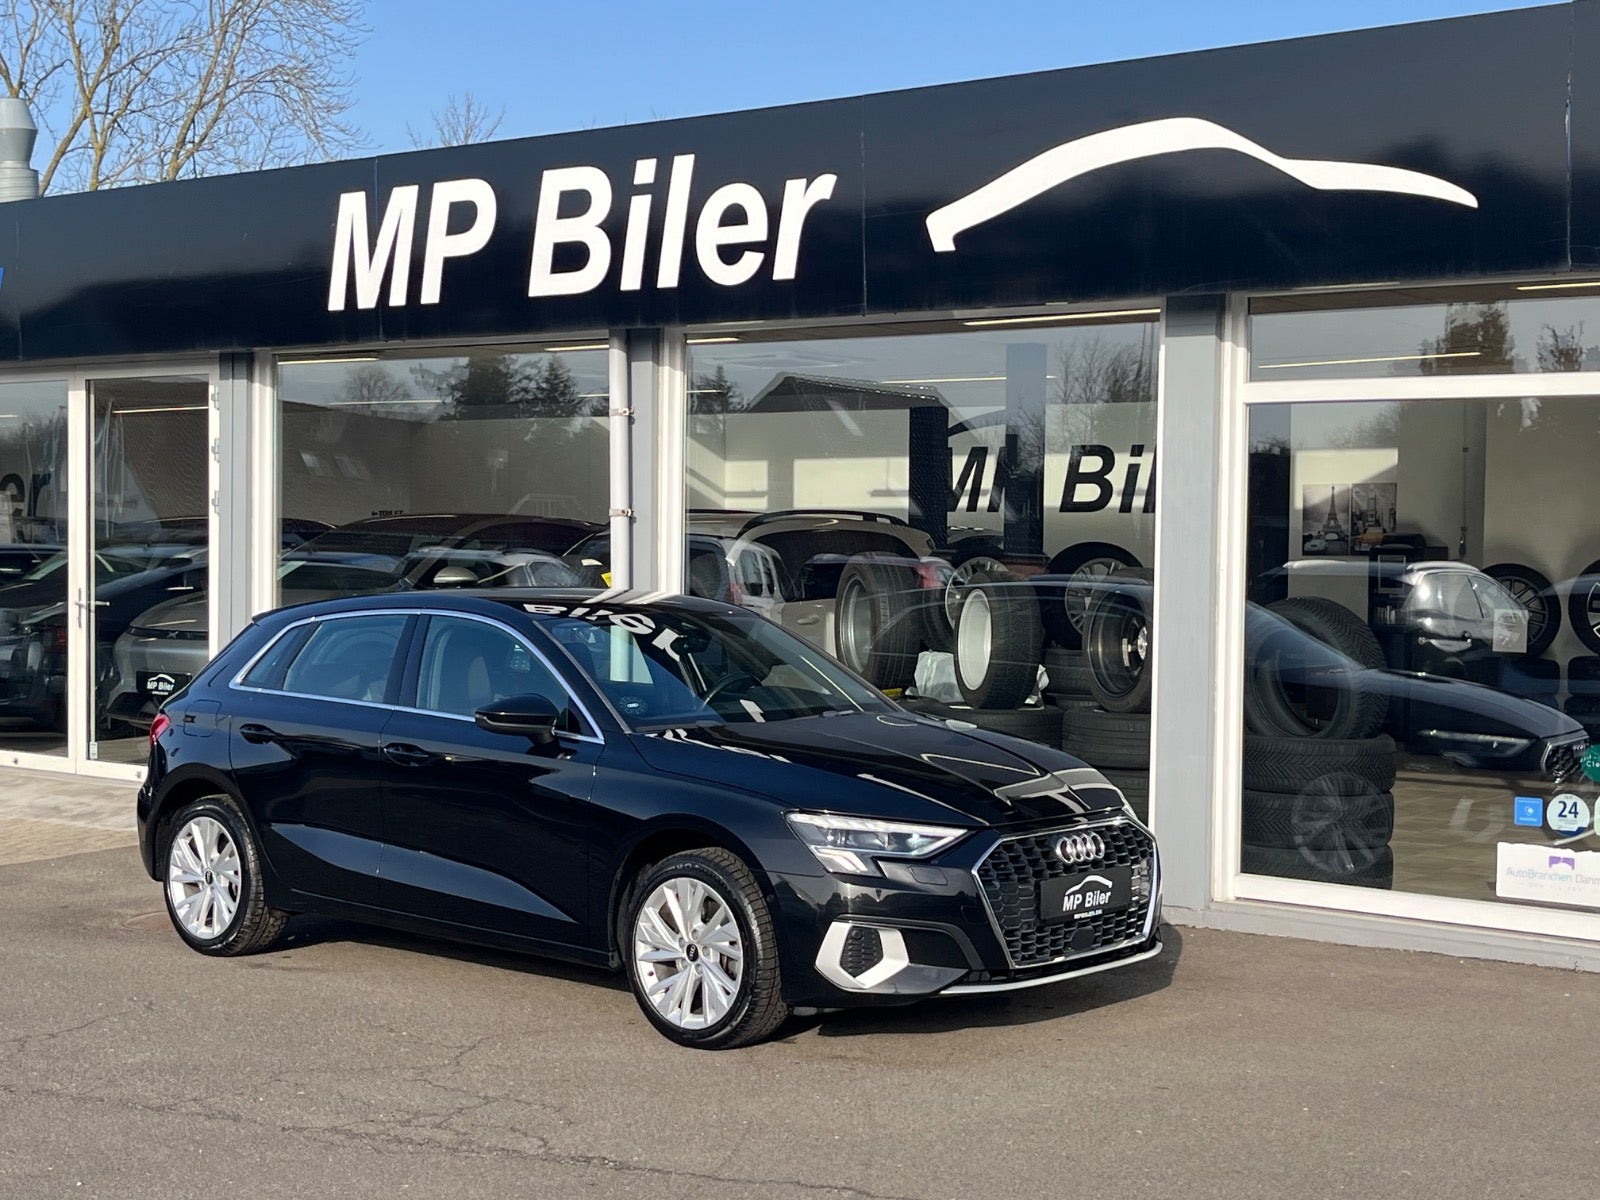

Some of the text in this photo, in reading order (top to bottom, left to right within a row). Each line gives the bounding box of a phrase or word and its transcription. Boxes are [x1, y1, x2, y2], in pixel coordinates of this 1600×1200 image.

[328, 154, 837, 311] MP Biler
[147, 681, 174, 691] MP Biler
[1557, 800, 1579, 819] 24
[1506, 867, 1572, 882] AutoBranchen
[1063, 890, 1111, 912] MP Biler
